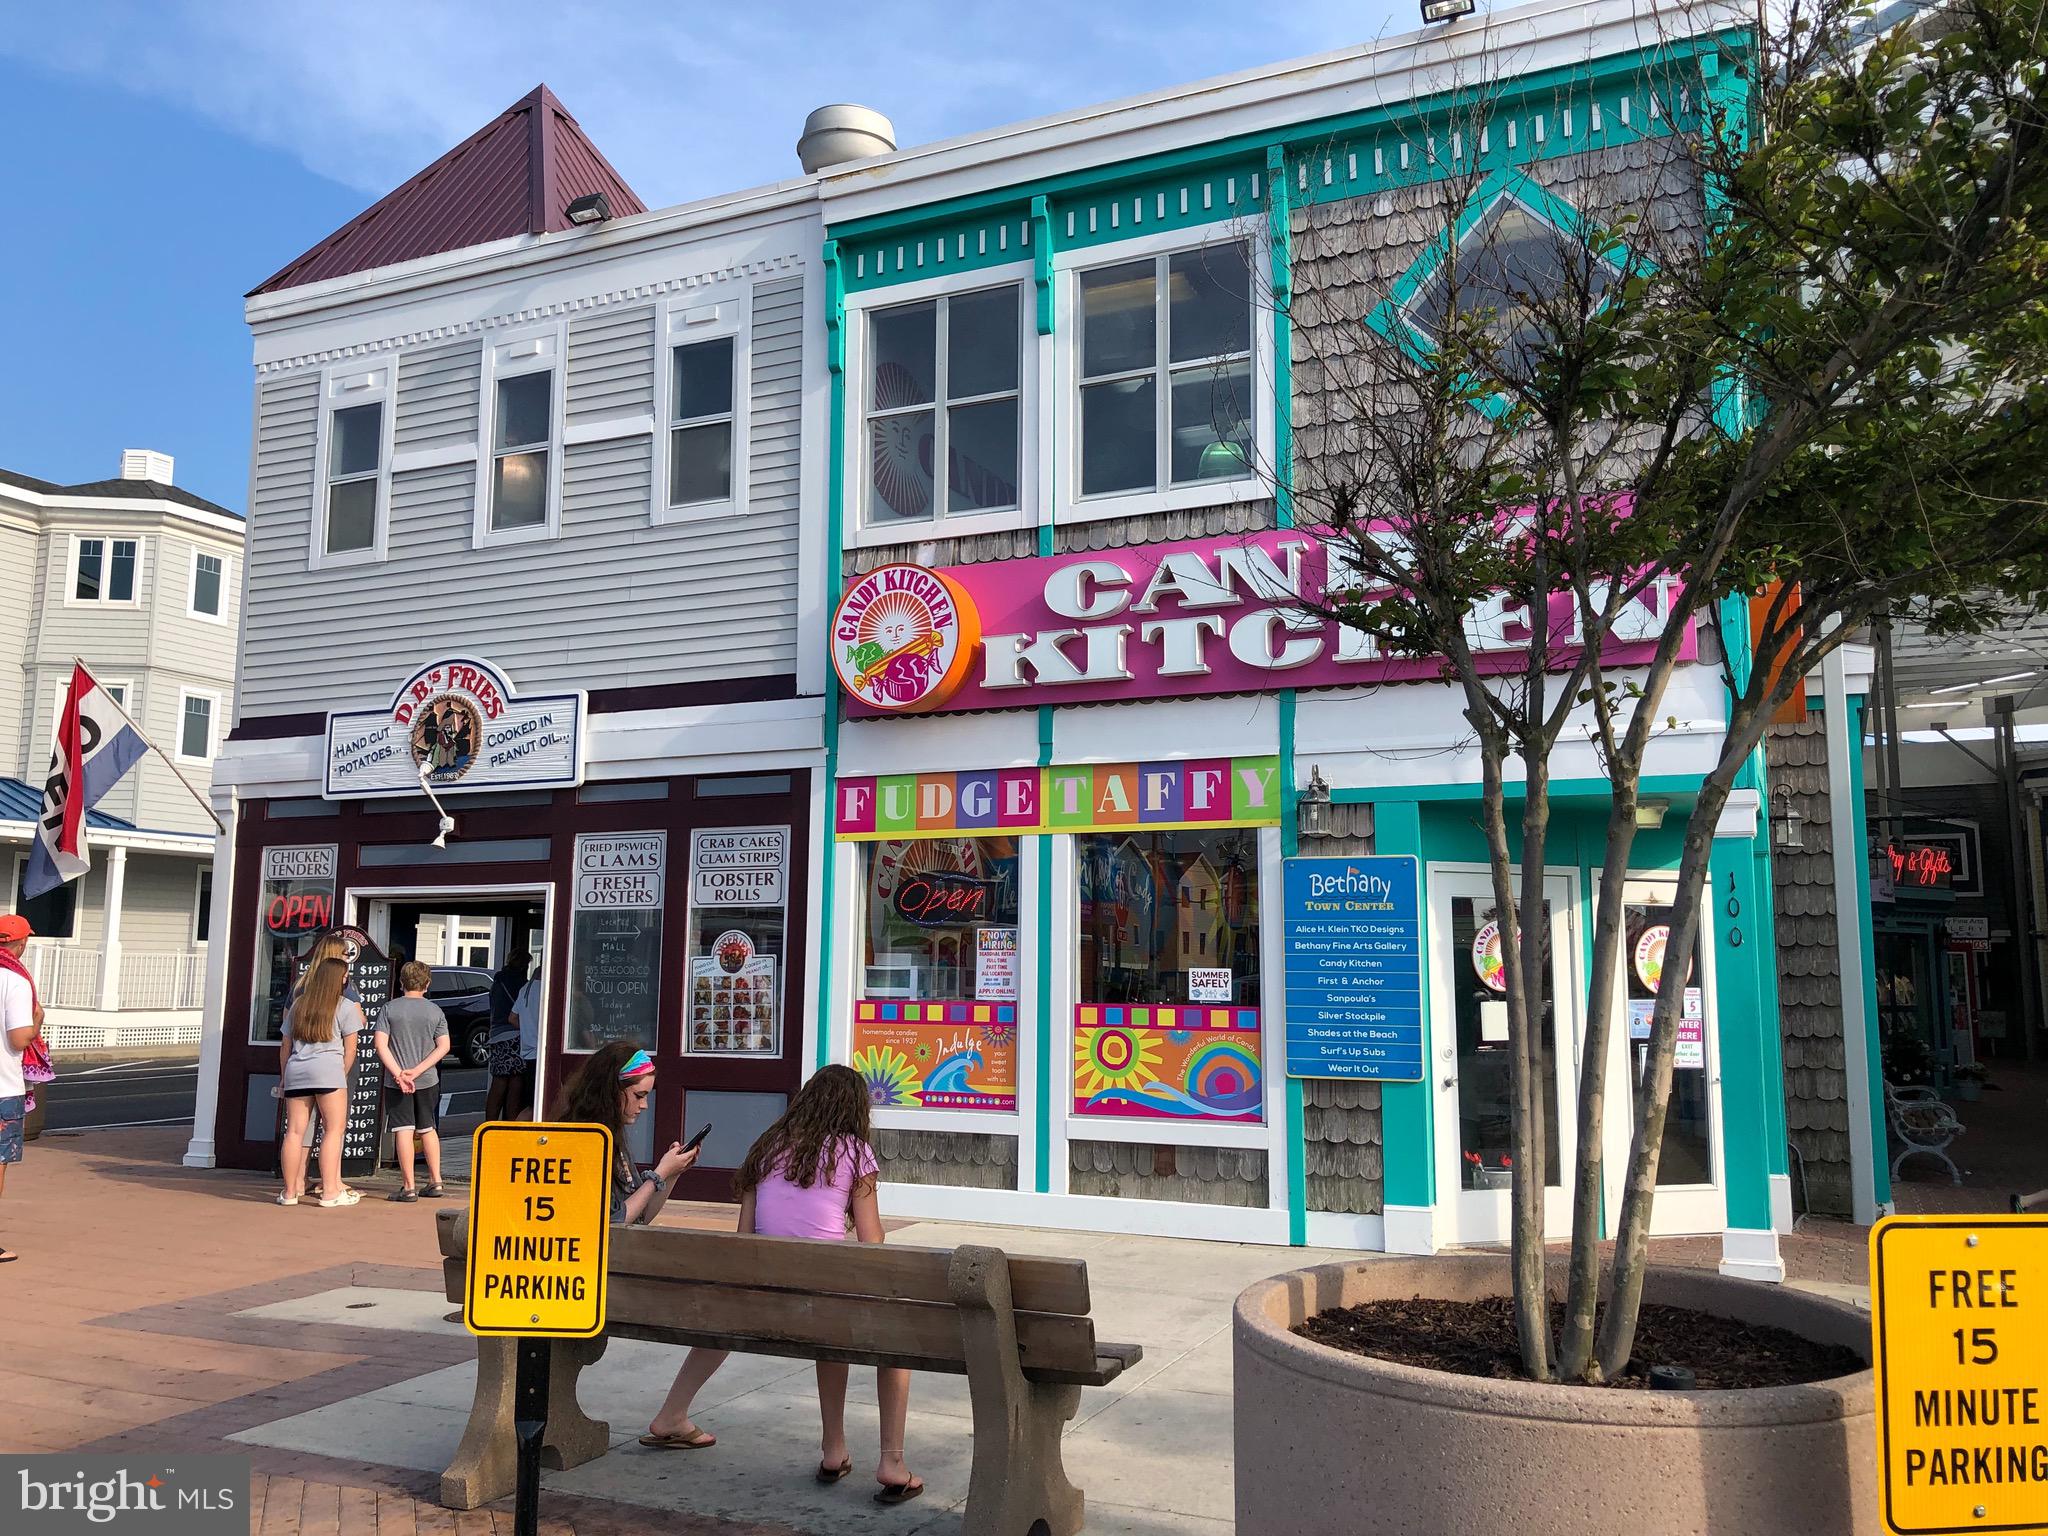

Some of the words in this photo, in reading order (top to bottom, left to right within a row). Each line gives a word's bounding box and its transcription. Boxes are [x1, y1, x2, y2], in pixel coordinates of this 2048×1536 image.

[838, 575, 881, 641] CANDY
[883, 569, 953, 630] KITCHEN
[448, 665, 504, 720] FRIES
[487, 720, 537, 748] COOKED
[540, 713, 553, 730] IN
[336, 736, 368, 758] HAND
[370, 727, 391, 745] CUT
[490, 743, 537, 768] PEANUT
[842, 778, 1034, 823] FUDGE
[1055, 767, 1276, 815] TAFFY
[584, 843, 613, 852] FRIED
[615, 841, 658, 851] IPSWICH
[700, 837, 734, 849] CRAB
[740, 835, 781, 848] CAKES
[272, 851, 330, 863] CHICKEN
[584, 853, 658, 868] CLAMS
[700, 853, 737, 864] CLAM
[739, 852, 780, 863] STRIPS
[272, 863, 330, 876] TENDERS
[593, 876, 646, 890] FRESH
[702, 872, 775, 887] LOBSTER
[1309, 866, 1391, 903] Bethany
[585, 890, 653, 904] OYSTERS
[714, 888, 761, 902] ROLLS
[900, 881, 984, 920] Open
[268, 895, 332, 929] OPEN
[1305, 901, 1340, 911] TOWN
[1344, 901, 1395, 911] CENTER
[988, 931, 1009, 940] NOW
[1295, 925, 1316, 933] Alice
[1317, 925, 1326, 933] H.
[1328, 925, 1349, 933] Klein
[1350, 925, 1368, 933] TKO
[1370, 925, 1405, 936] Designs
[1294, 942, 1331, 952] Bethany
[1332, 942, 1351, 950] Fine
[1352, 942, 1373, 950] Arts
[1374, 942, 1407, 952] Gallery
[1319, 959, 1347, 968] Candy
[1349, 959, 1382, 968] Kitchen
[1191, 971, 1230, 979] SUMMER
[1318, 977, 1338, 985] First
[1342, 977, 1349, 985] &
[1352, 977, 1384, 986] Anchor
[617, 981, 649, 995] OPEN
[1191, 979, 1230, 988] SAFELY
[1690, 1001, 1696, 1012] 5
[1318, 1012, 1343, 1020] Silver
[1345, 1012, 1386, 1022] Stockpile
[862, 1028, 895, 1036] homemade
[896, 1028, 918, 1036] candies
[1679, 1021, 1699, 1029] NTER
[902, 1037, 917, 1045] 1937
[1307, 1029, 1341, 1037] Shades
[1353, 1029, 1368, 1038] the
[1369, 1030, 1398, 1039] Beach
[935, 1028, 982, 1064] Indulge
[1320, 1046, 1347, 1055] Surf's
[1348, 1048, 1361, 1057] Up
[1363, 1047, 1386, 1056] Subs
[993, 1050, 1006, 1058] your
[1176, 1068, 1186, 1081] The
[1181, 1040, 1206, 1067] Wonderful
[1206, 1034, 1226, 1043] World
[1236, 1036, 1257, 1053] Candy
[991, 1066, 1007, 1074] tooth
[1328, 1064, 1352, 1073] Wear
[1354, 1064, 1361, 1072] It
[1362, 1064, 1379, 1073] Out
[510, 1157, 573, 1184] FREE
[524, 1196, 555, 1221] 15
[493, 1235, 581, 1262] MINUTE
[485, 1274, 585, 1301] PARKING
[1929, 1269, 2018, 1309] FREE
[1953, 1328, 1998, 1365] 15
[1914, 1387, 2040, 1427] MINUTE
[1906, 1445, 2048, 1487] PARKING
